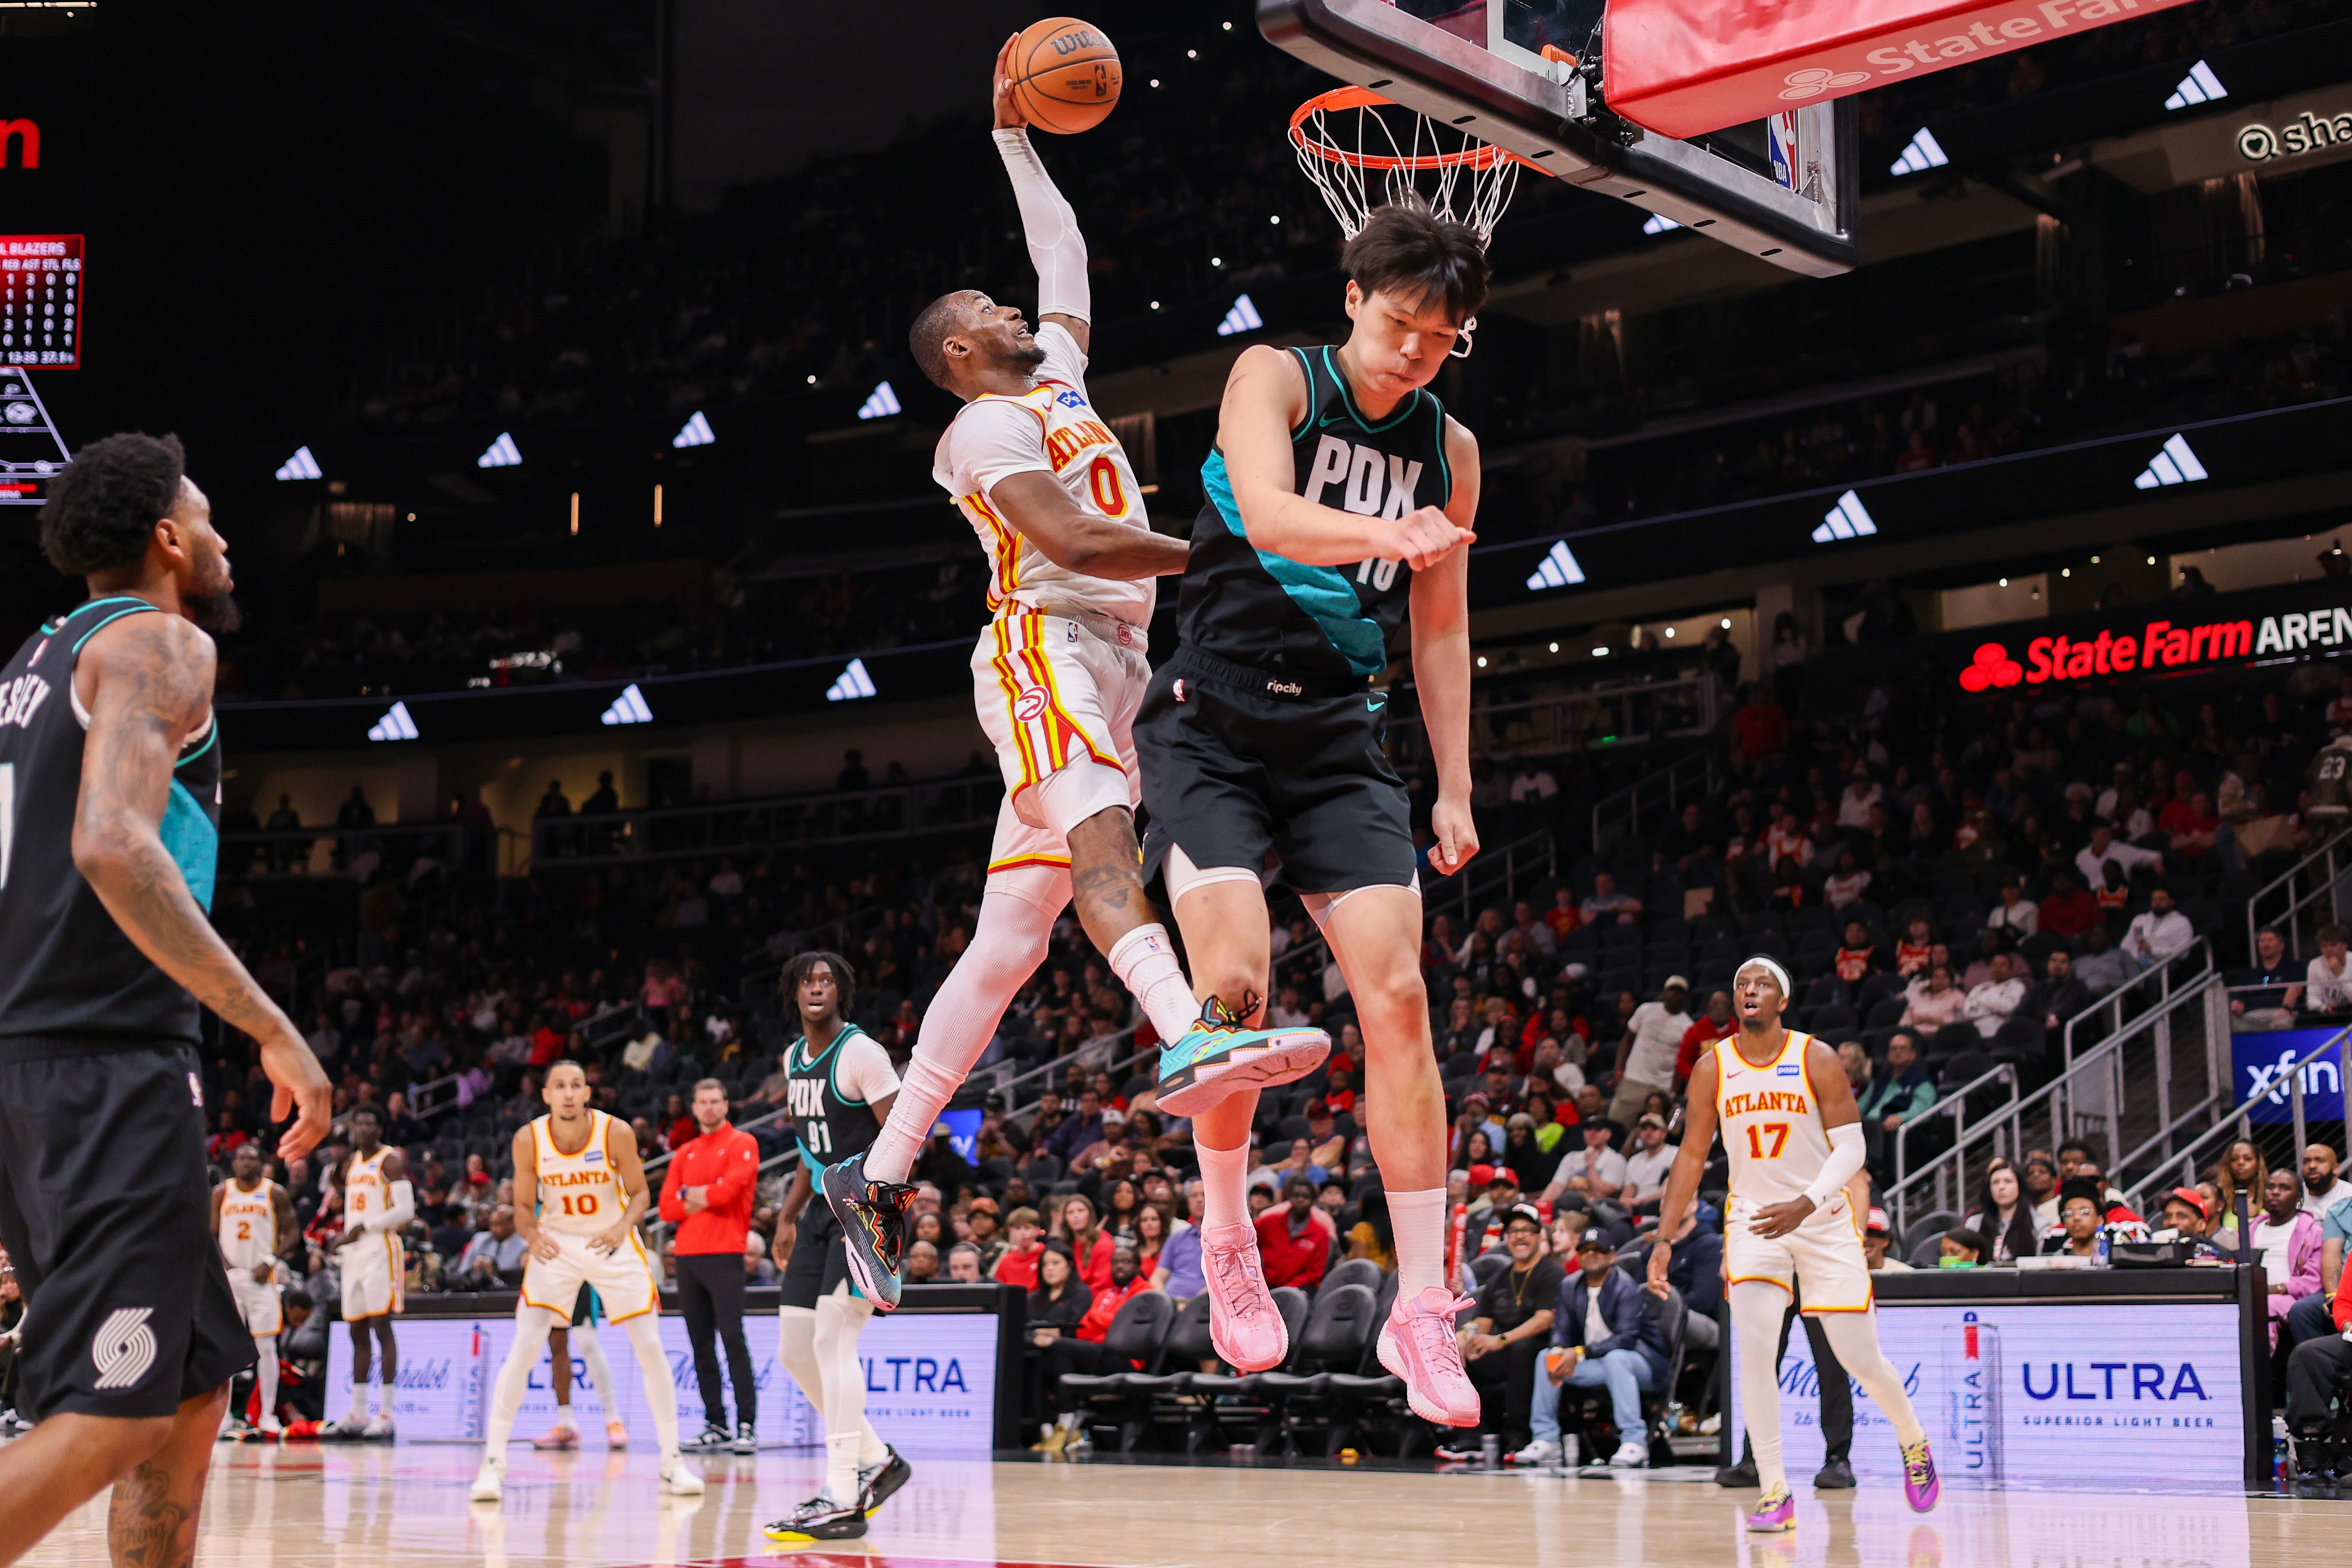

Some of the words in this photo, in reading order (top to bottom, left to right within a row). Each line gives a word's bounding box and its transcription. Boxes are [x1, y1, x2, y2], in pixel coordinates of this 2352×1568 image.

[1866, 17, 2043, 75] State
[2038, 0, 2163, 29] Fa
[2283, 112, 2352, 154] sha
[1773, 160, 1787, 183] NBA
[9, 242, 66, 256] BLAZERS
[6, 273, 15, 285] 1
[46, 273, 56, 286] 0
[66, 273, 76, 286] 0
[6, 288, 14, 301] 1
[26, 288, 35, 301] 1
[46, 288, 54, 301] 1
[66, 288, 74, 301] 1
[5, 303, 14, 316] 1
[25, 303, 34, 316] 1
[44, 303, 55, 316] 0
[64, 303, 75, 316] 0
[24, 319, 33, 332] 1
[44, 318, 54, 332] 0
[3, 334, 13, 347] 0
[24, 334, 32, 346] 1
[44, 334, 52, 346] 1
[64, 334, 72, 346] 1
[1046, 420, 1123, 474] ATLAN
[1089, 455, 1128, 518] 0
[1304, 434, 1423, 521] PDX
[1117, 627, 1132, 640] HAWKS
[2025, 634, 2137, 684] State
[2141, 620, 2253, 669] Farm
[1267, 680, 1302, 696] ripcity
[2246, 1050, 2344, 1104] xfin
[788, 1079, 826, 1117] PDX
[1725, 1091, 1808, 1118] ATLANTA
[808, 1120, 833, 1154] 91
[1747, 1122, 1791, 1159] 17
[543, 1171, 611, 1186] ATLANTA
[562, 1194, 599, 1215] 10
[237, 1221, 250, 1239] 2
[859, 1357, 967, 1392] LTRA
[1964, 1370, 1983, 1468] ULTRA
[2023, 1416, 2103, 1425] SUPERIOR
[2114, 1417, 2162, 1426] LIGHT
[2173, 1417, 2213, 1427] BEER
